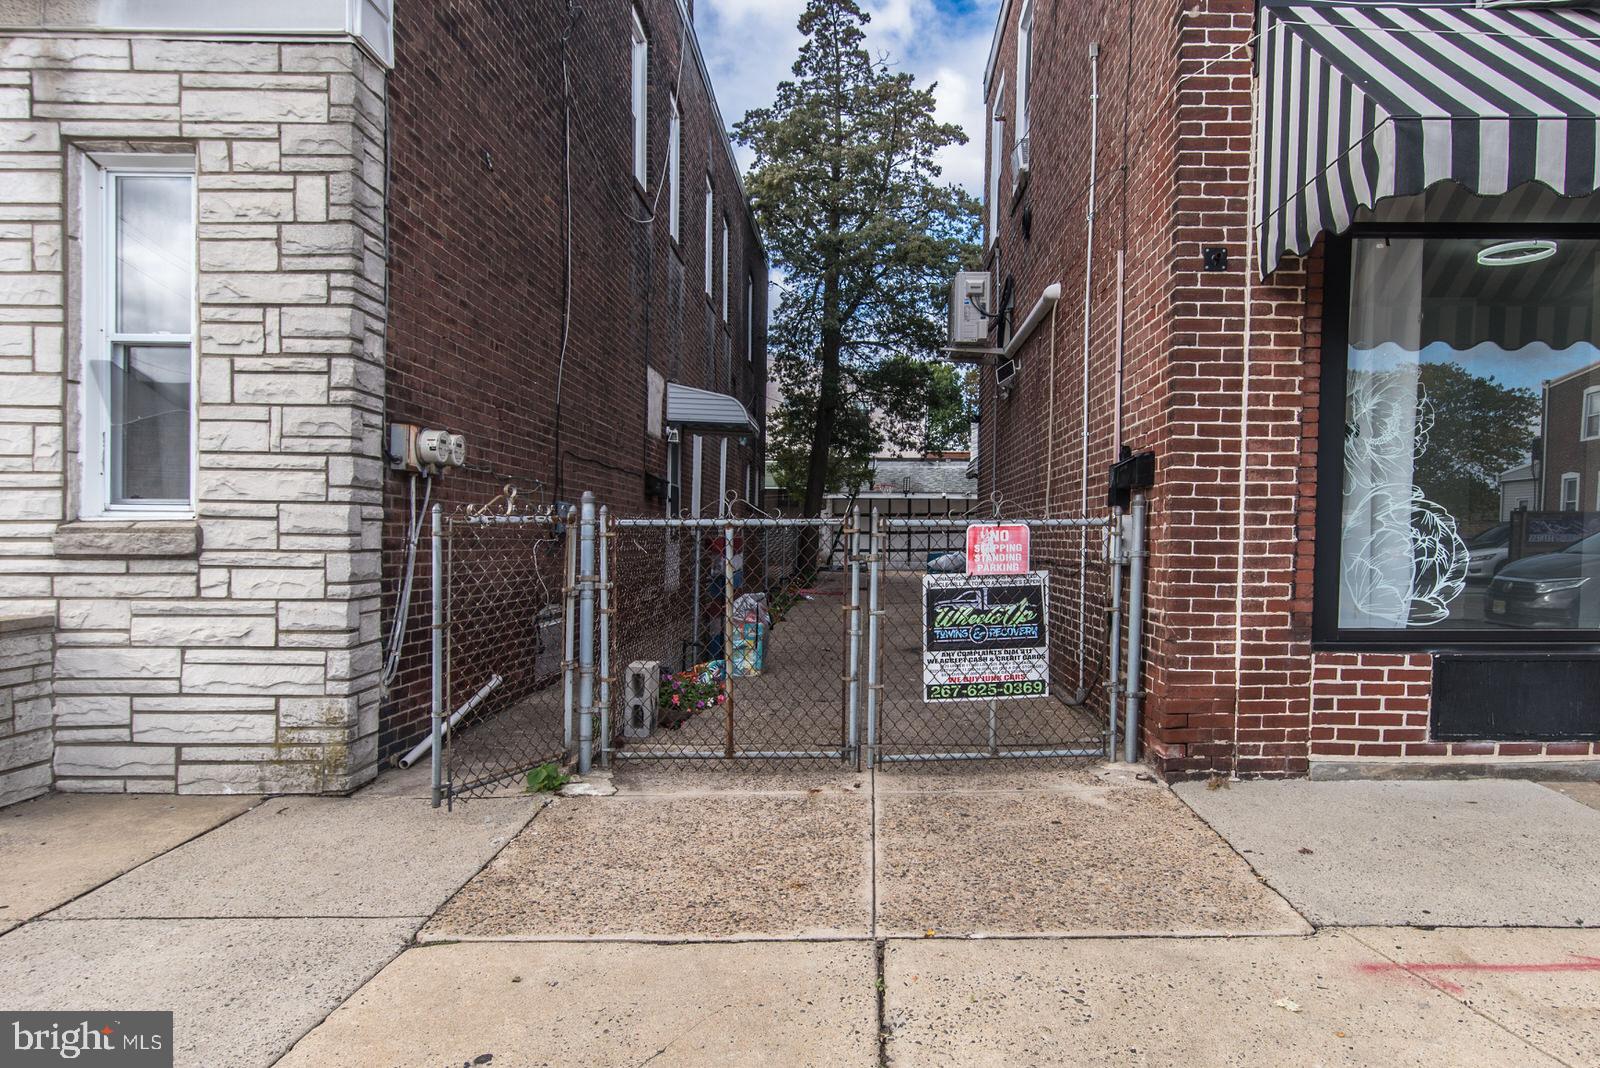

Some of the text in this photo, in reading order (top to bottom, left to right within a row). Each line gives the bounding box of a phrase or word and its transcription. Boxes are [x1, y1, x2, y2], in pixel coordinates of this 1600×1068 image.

[986, 529, 1009, 542] NO
[974, 553, 1022, 562] STANDING
[977, 562, 1019, 572] PARKING
[934, 629, 968, 639] TOWING
[989, 626, 1038, 638] RECOVERY
[930, 681, 1043, 698] 267-625-0369
